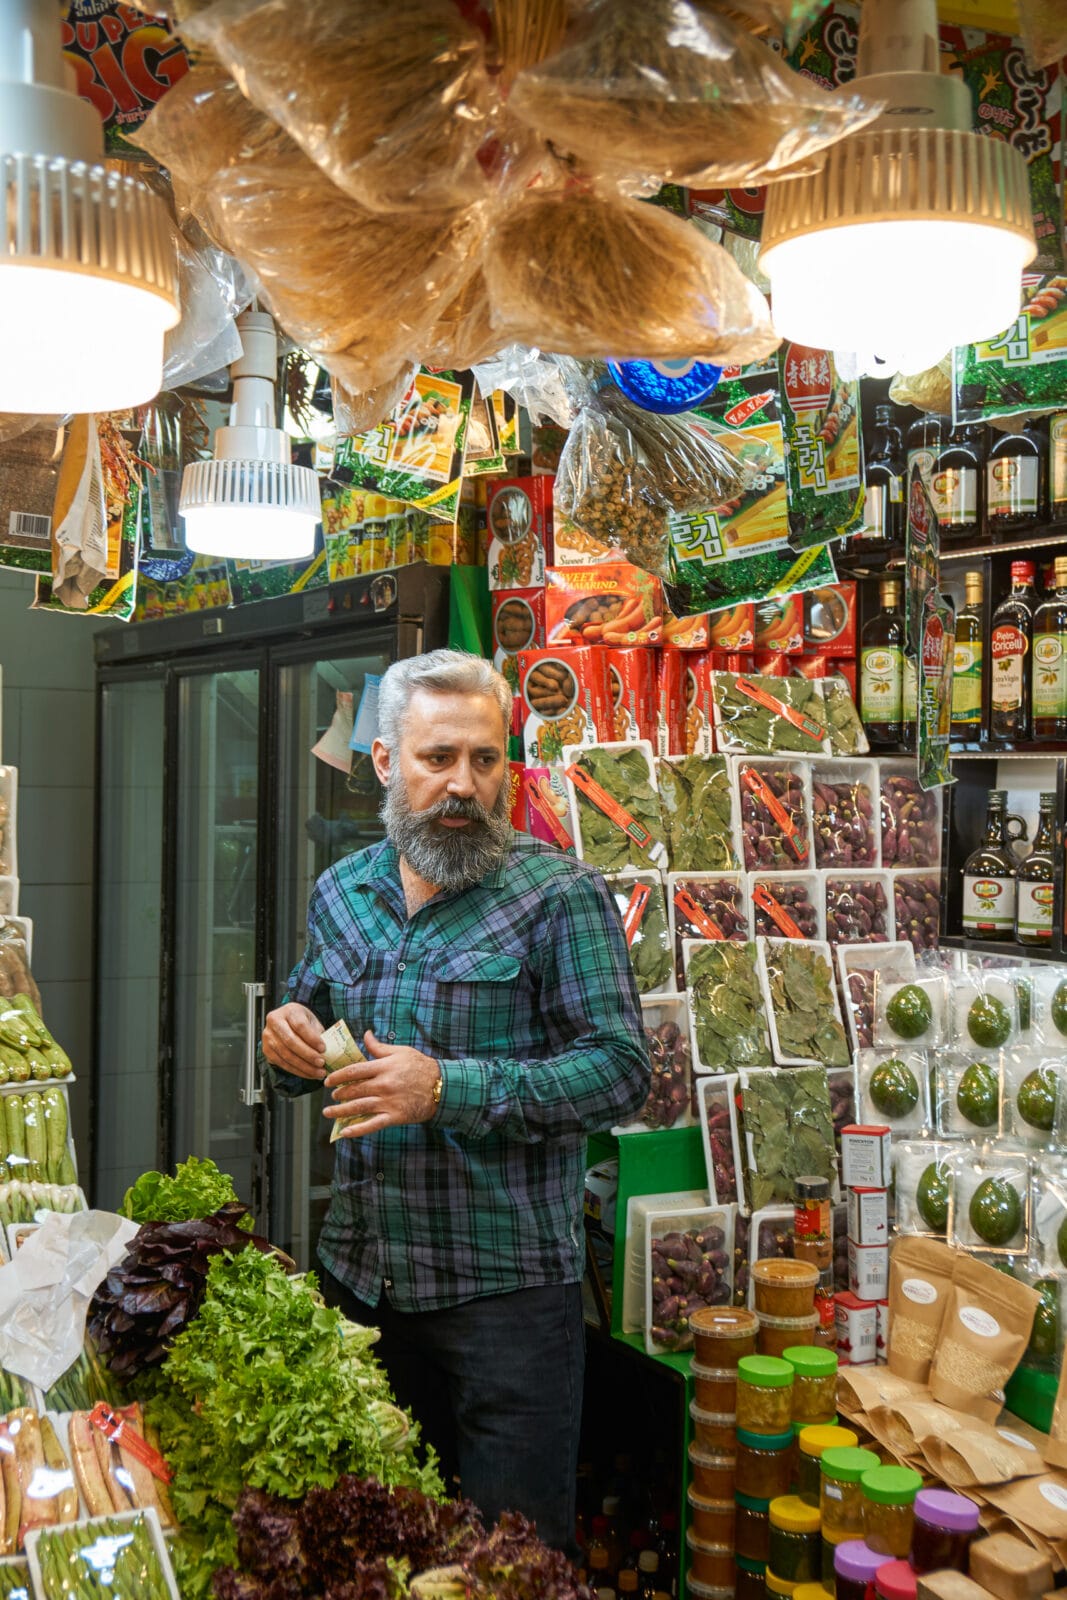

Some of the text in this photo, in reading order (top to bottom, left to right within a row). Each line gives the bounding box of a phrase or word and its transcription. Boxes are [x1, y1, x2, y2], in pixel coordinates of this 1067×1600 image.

[63, 27, 191, 121] BIG
[793, 425, 826, 488] 돌김
[535, 558, 544, 583] Sweet
[559, 554, 584, 566] Sweet
[584, 688, 592, 731] Tamarind
[628, 689, 637, 732] Tamarind
[702, 690, 710, 755] weet Tamarind
